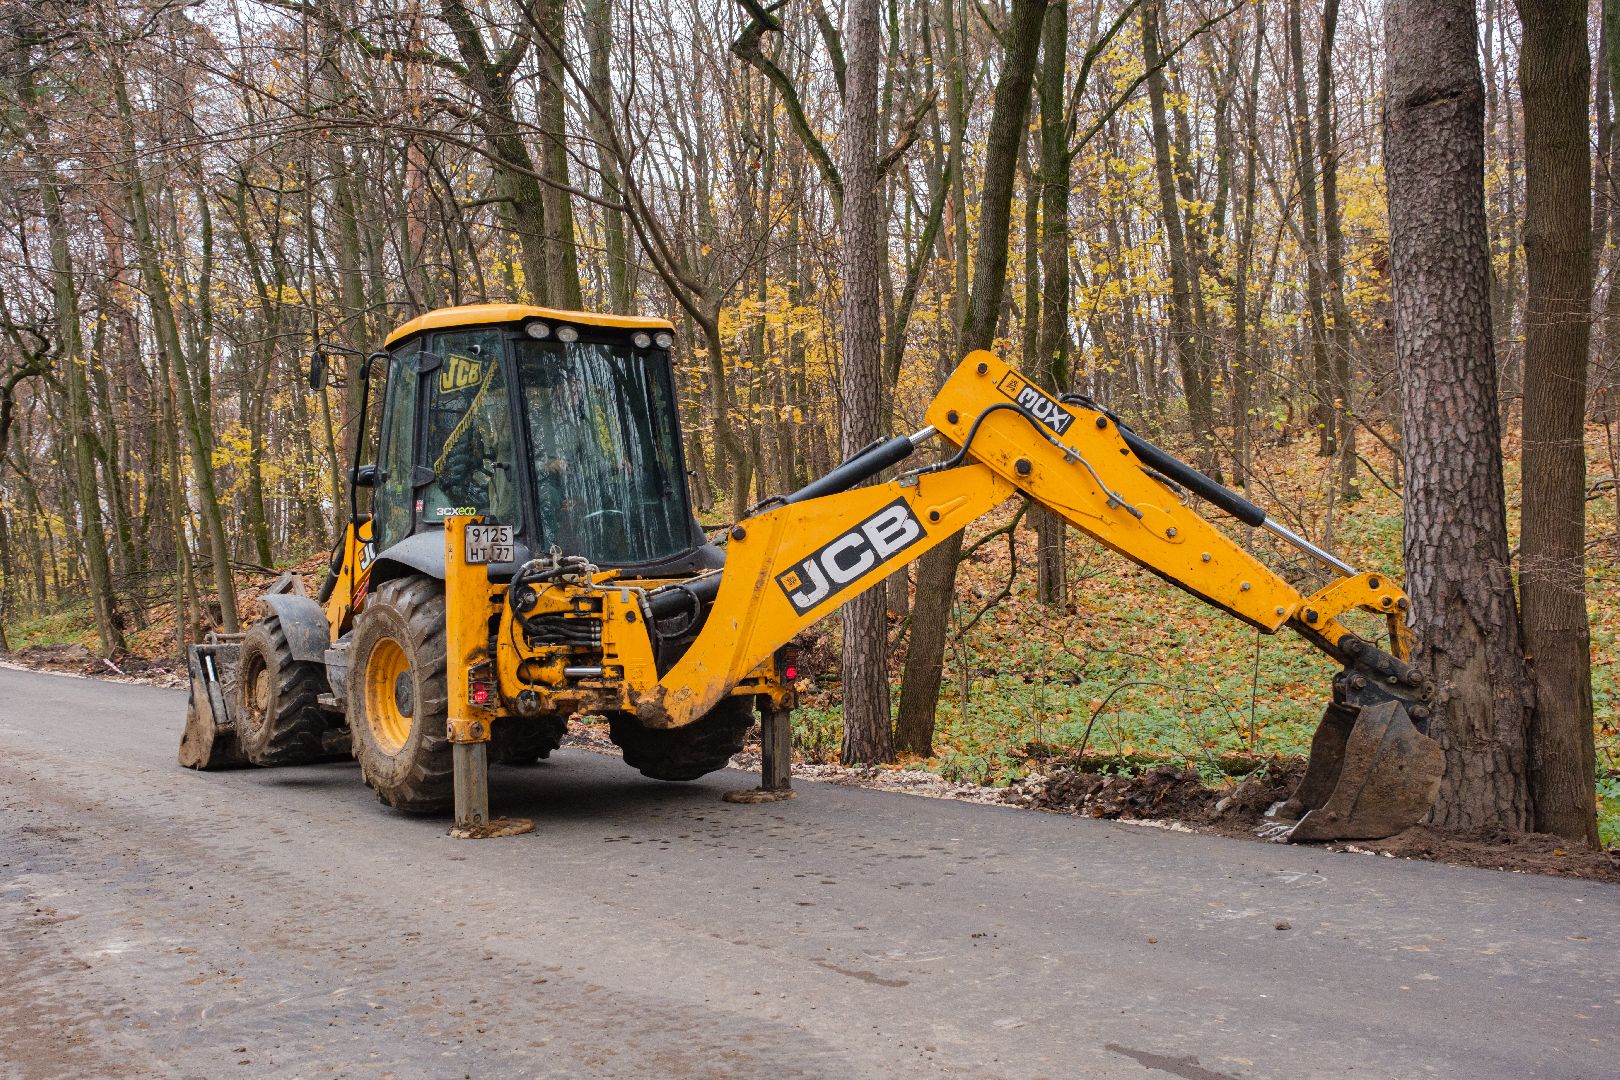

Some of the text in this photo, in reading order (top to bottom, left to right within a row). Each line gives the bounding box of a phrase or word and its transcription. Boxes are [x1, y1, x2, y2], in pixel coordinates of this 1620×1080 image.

[443, 356, 479, 389] JCB
[472, 528, 508, 543] 9125
[496, 548, 510, 560] 77
[792, 505, 920, 608] JCB
